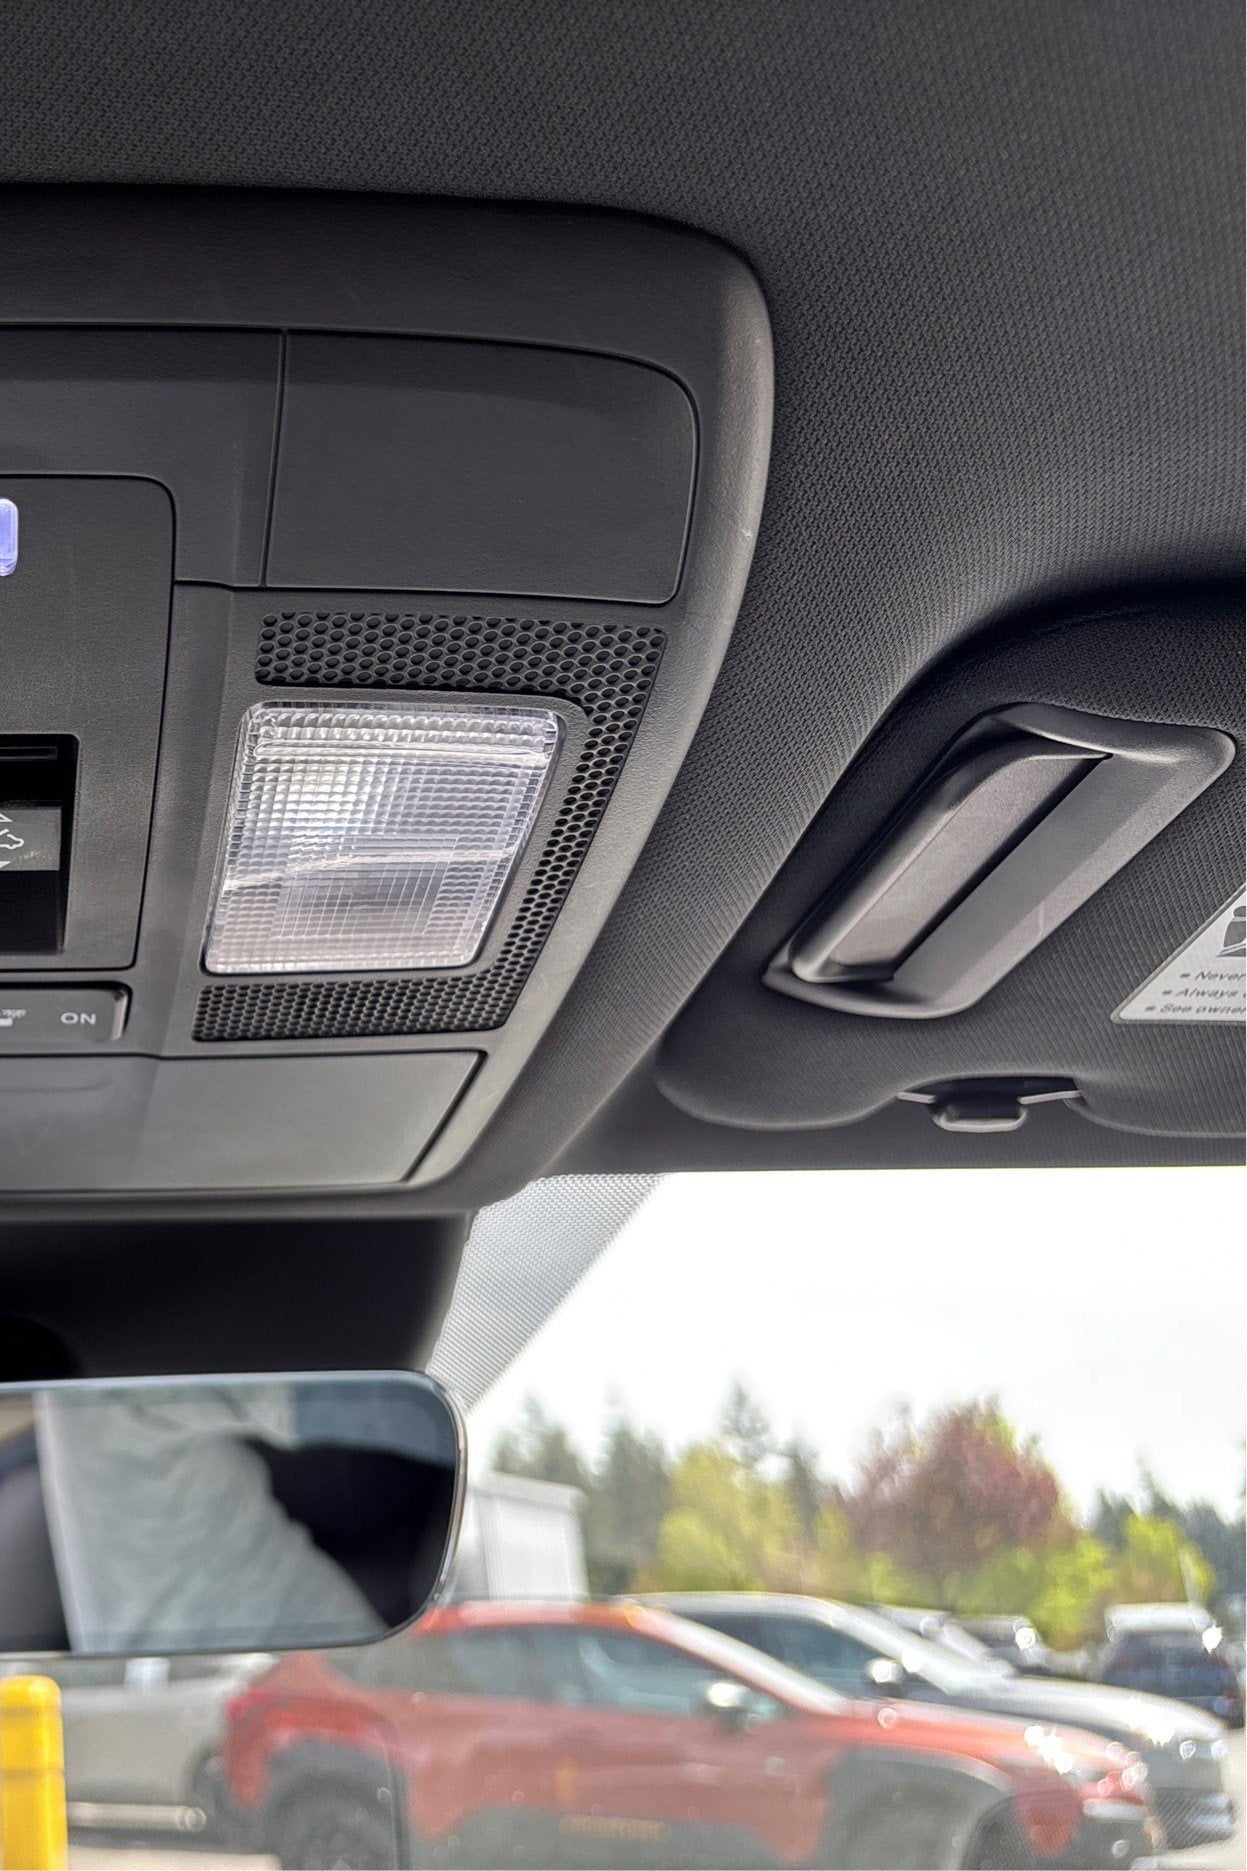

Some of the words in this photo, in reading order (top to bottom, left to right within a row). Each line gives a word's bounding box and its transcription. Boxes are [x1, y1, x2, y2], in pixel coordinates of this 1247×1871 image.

[1175, 987, 1239, 999] Always
[1160, 1002, 1193, 1014] See
[60, 1011, 96, 1026] ON
